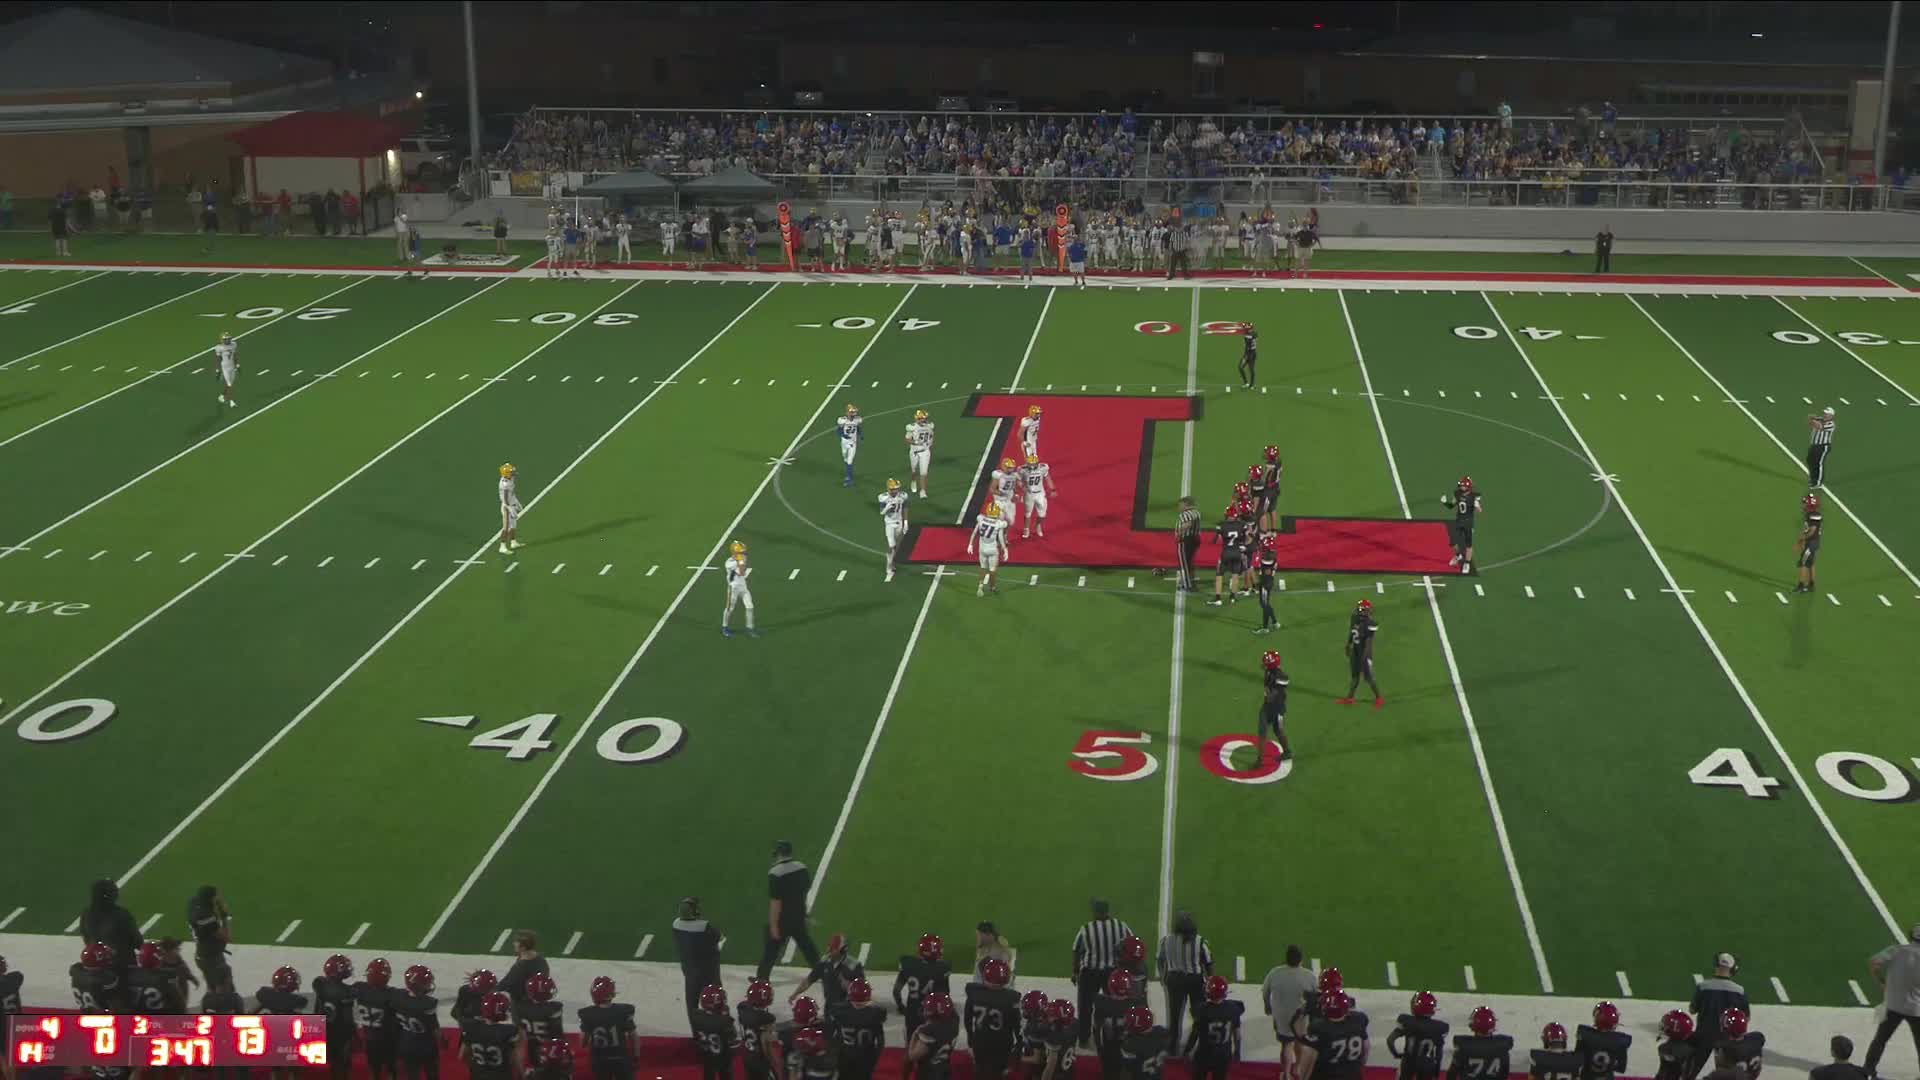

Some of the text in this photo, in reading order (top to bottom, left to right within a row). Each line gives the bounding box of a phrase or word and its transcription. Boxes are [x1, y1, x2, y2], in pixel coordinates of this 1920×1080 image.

[1228, 531, 1239, 546] 7
[0, 600, 92, 616] we
[468, 713, 684, 762] 40
[1066, 730, 1293, 784] 50
[1688, 747, 1911, 800] 40
[973, 1006, 1003, 1031] 73
[1330, 1036, 1362, 1064] 78
